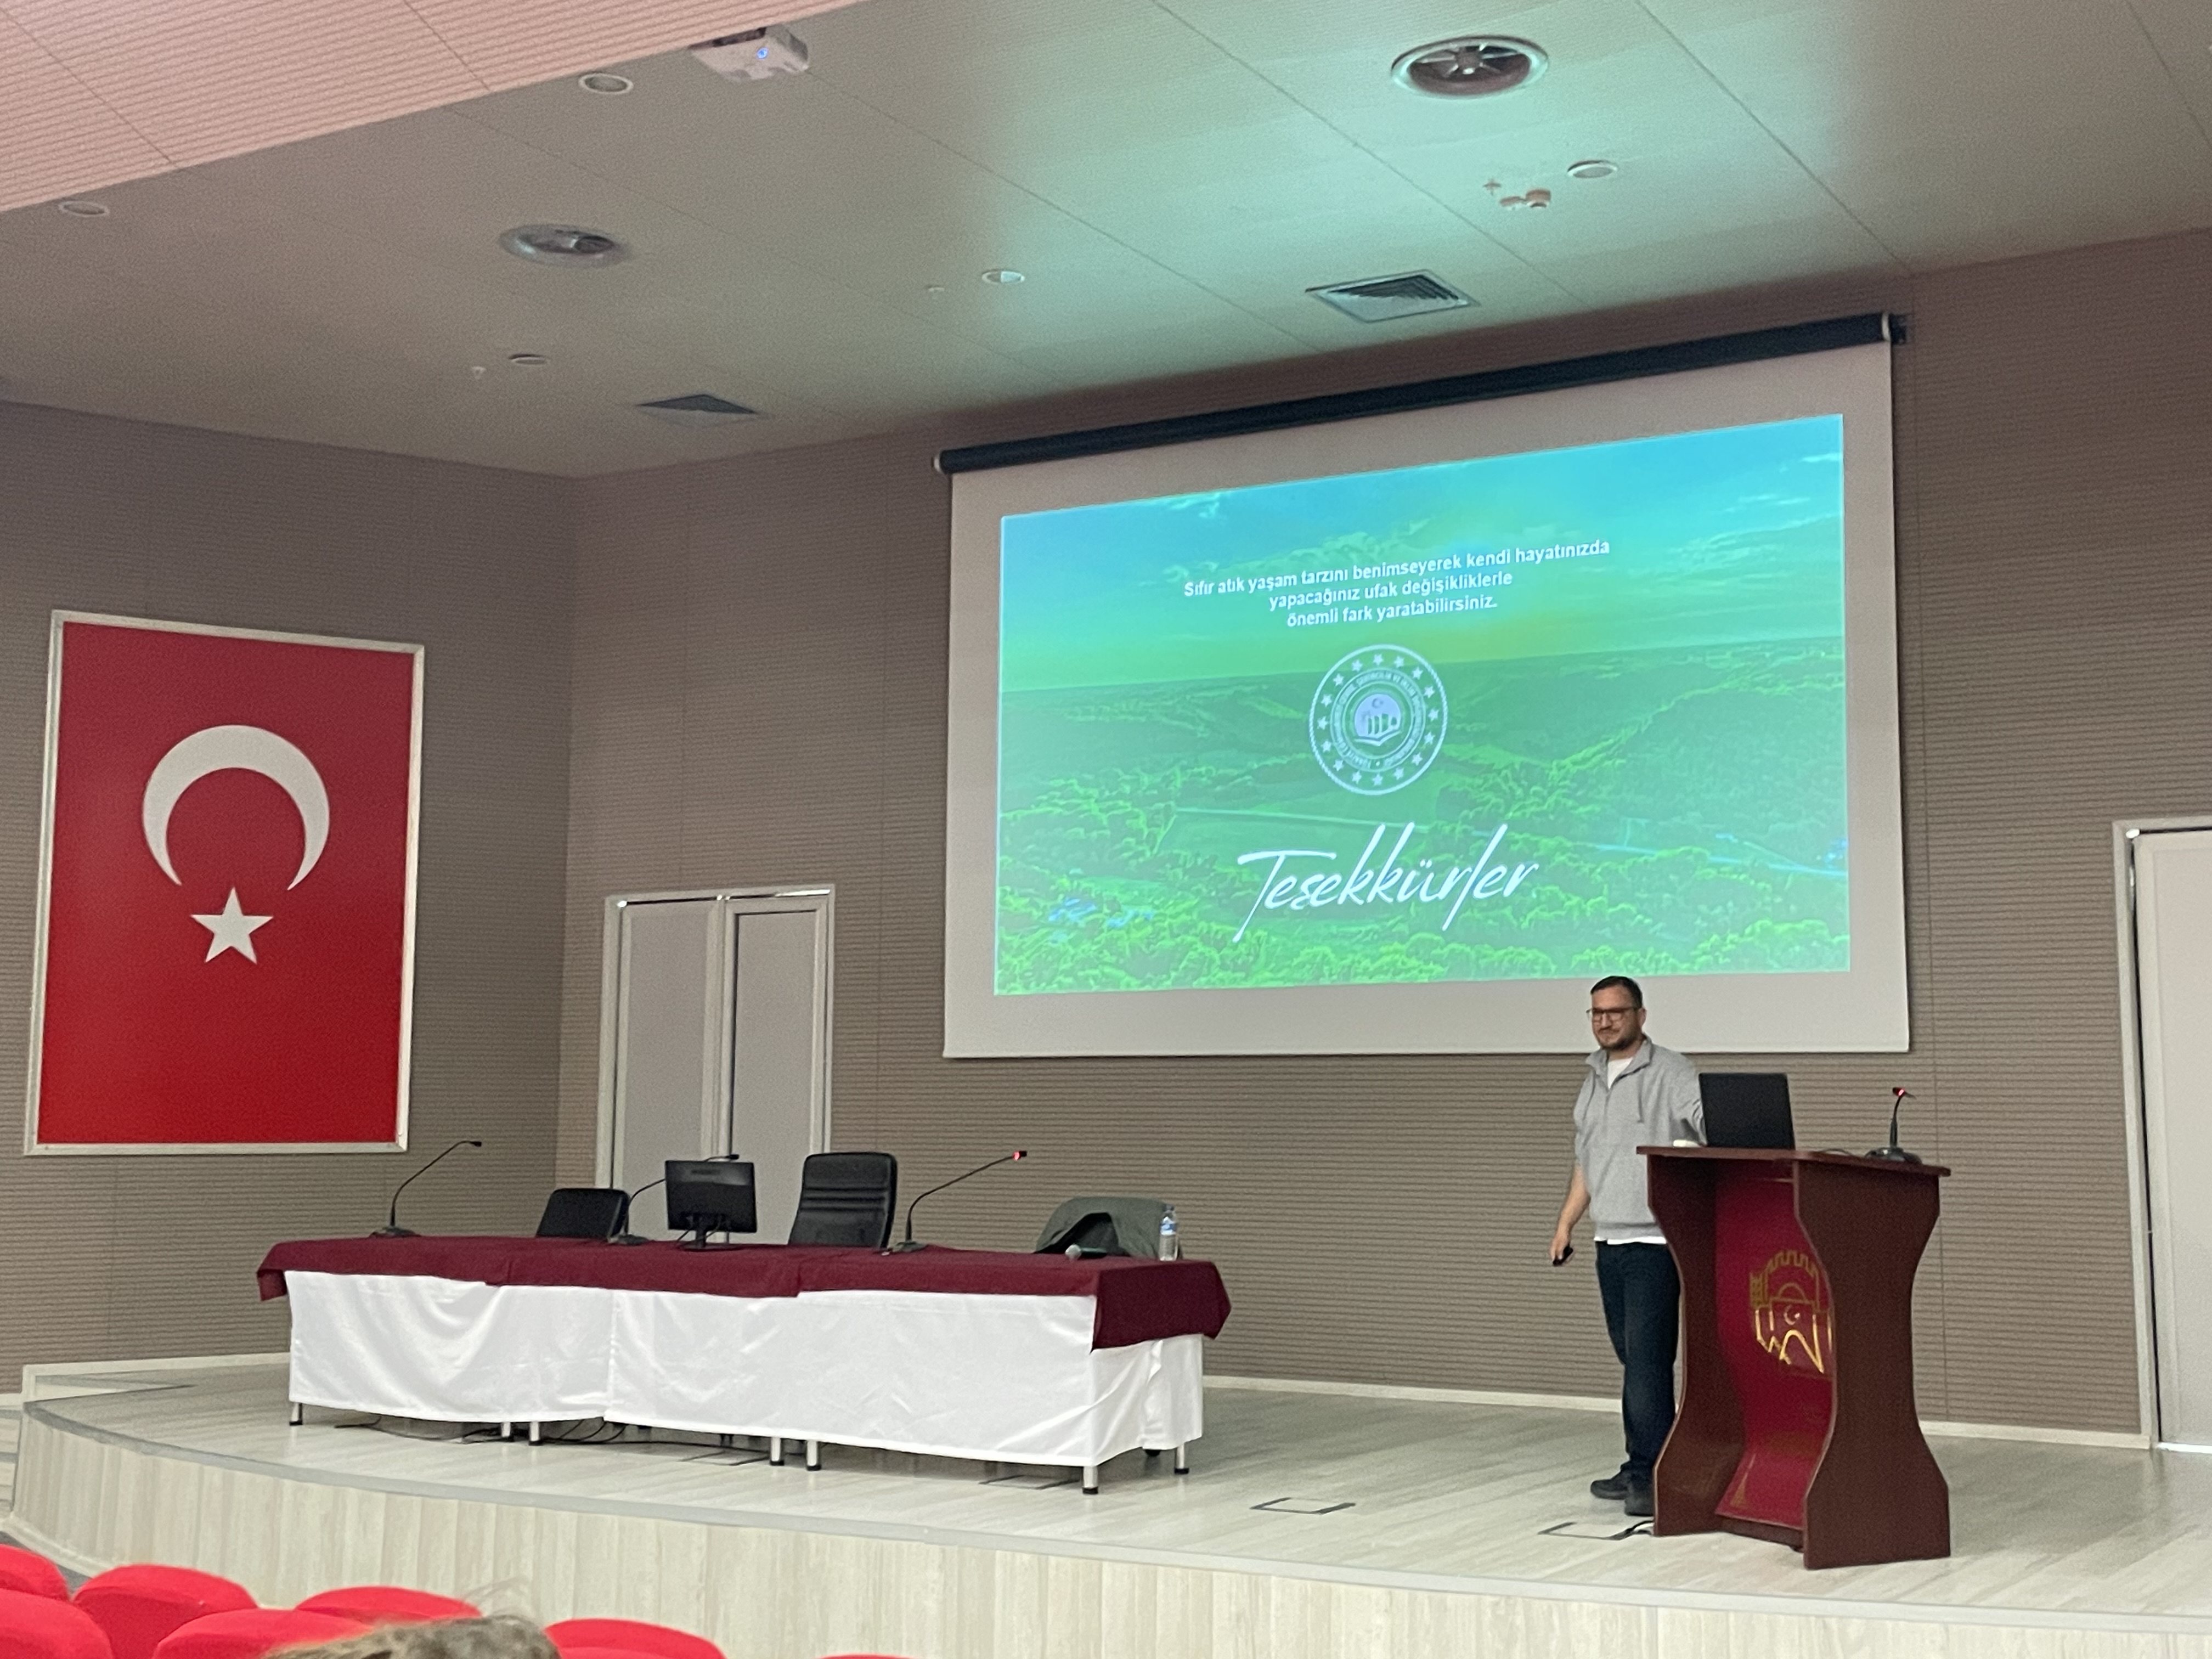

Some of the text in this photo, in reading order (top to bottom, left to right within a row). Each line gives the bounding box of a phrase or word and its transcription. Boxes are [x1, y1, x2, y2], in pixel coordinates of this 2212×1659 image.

[1184, 539, 1610, 596] Sıfır atık yaşam tarzını benimseyerek kendi hayatınızda
[1269, 571, 1513, 612] yapacağınız ufak değişikliklerle
[1287, 594, 1497, 627] önemli fark yaratabilirsiniz.
